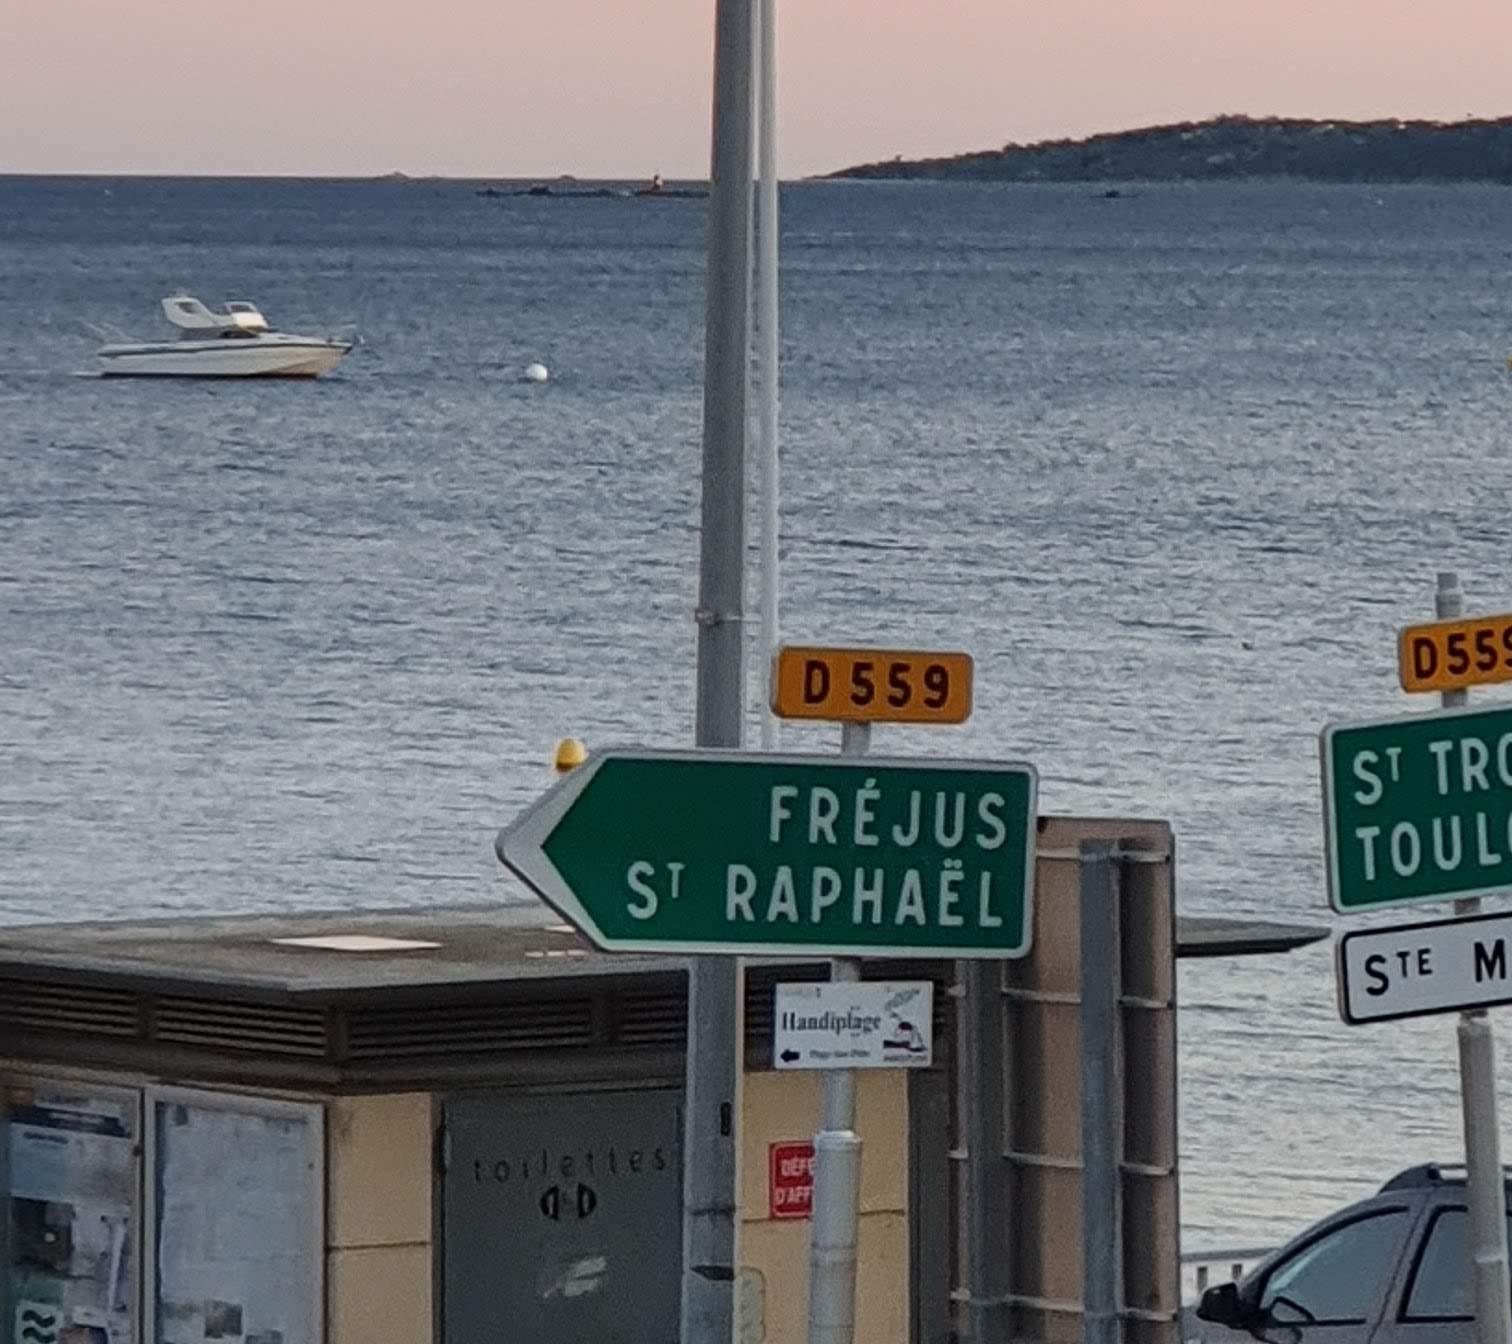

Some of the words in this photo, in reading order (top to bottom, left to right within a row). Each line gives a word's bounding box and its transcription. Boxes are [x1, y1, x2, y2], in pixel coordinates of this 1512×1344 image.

[803, 659, 831, 705] D
[850, 661, 950, 709] 559
[768, 778, 1008, 851] FRÉJUS
[726, 858, 1003, 929] RAPHAËL
[472, 1146, 668, 1183] toilettes
